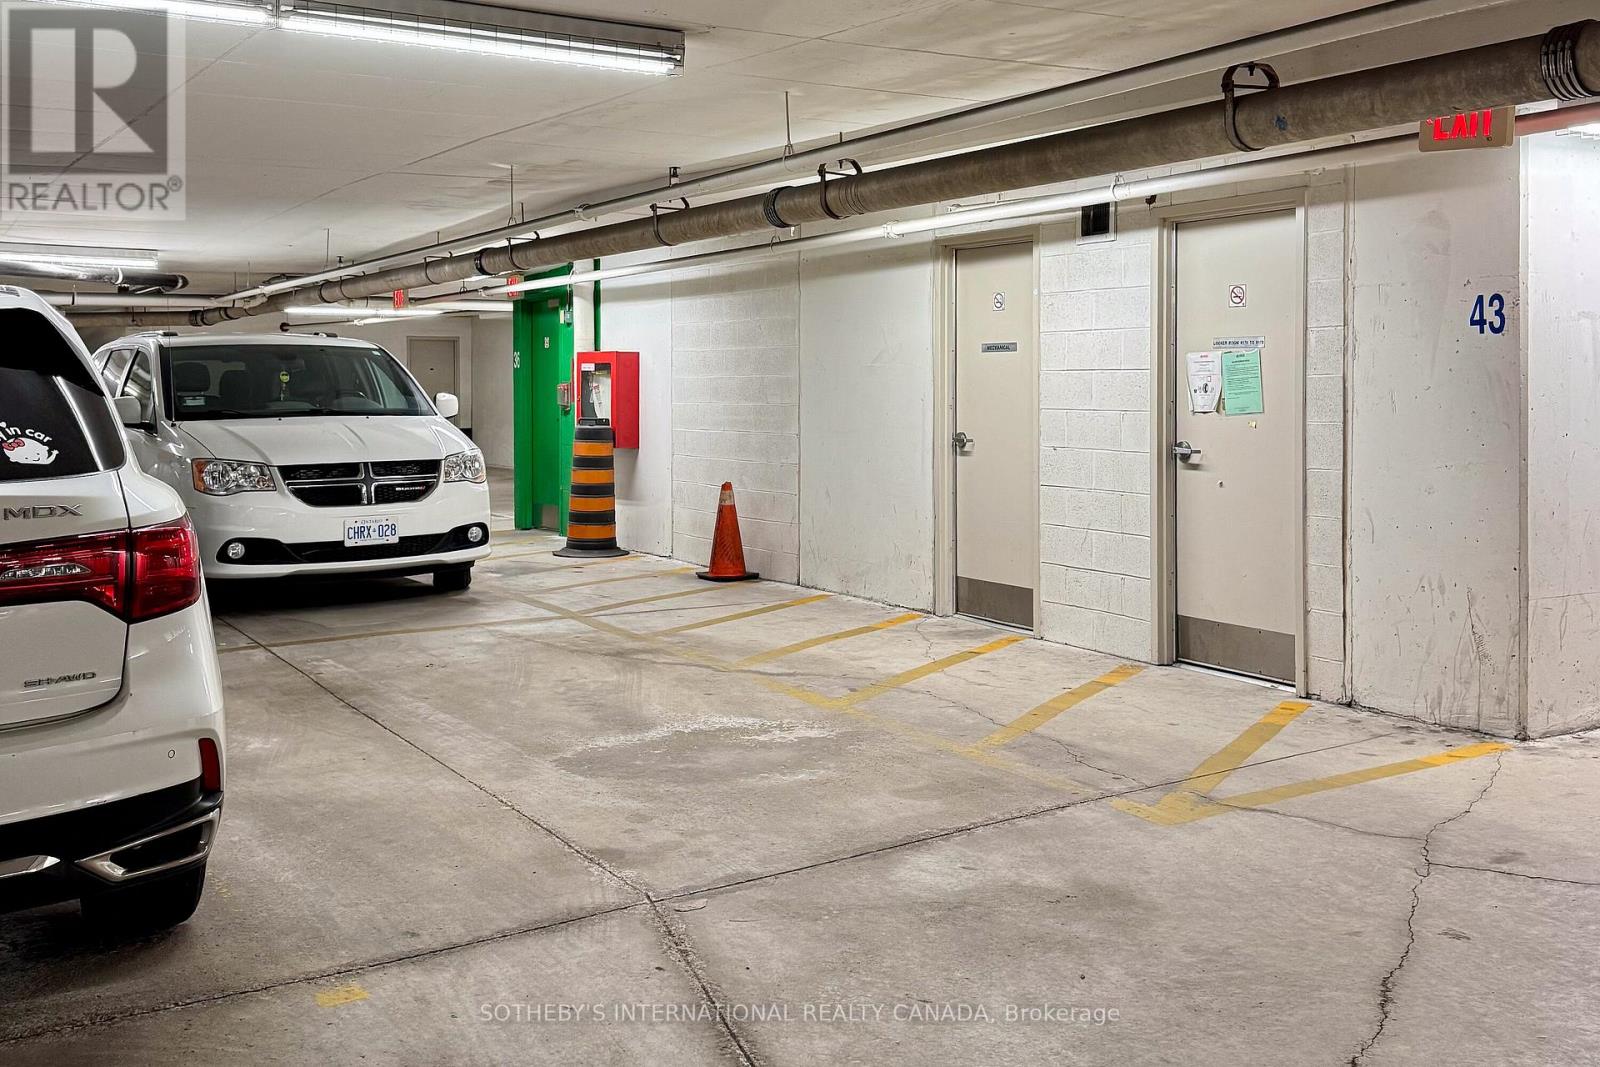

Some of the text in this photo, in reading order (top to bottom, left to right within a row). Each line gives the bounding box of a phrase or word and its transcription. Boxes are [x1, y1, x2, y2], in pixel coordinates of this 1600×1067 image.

[1468, 293, 1507, 335] 43
[513, 351, 521, 369] 36
[25, 428, 52, 442] car
[3, 504, 83, 520] MDX
[347, 523, 397, 540] CHRX 028
